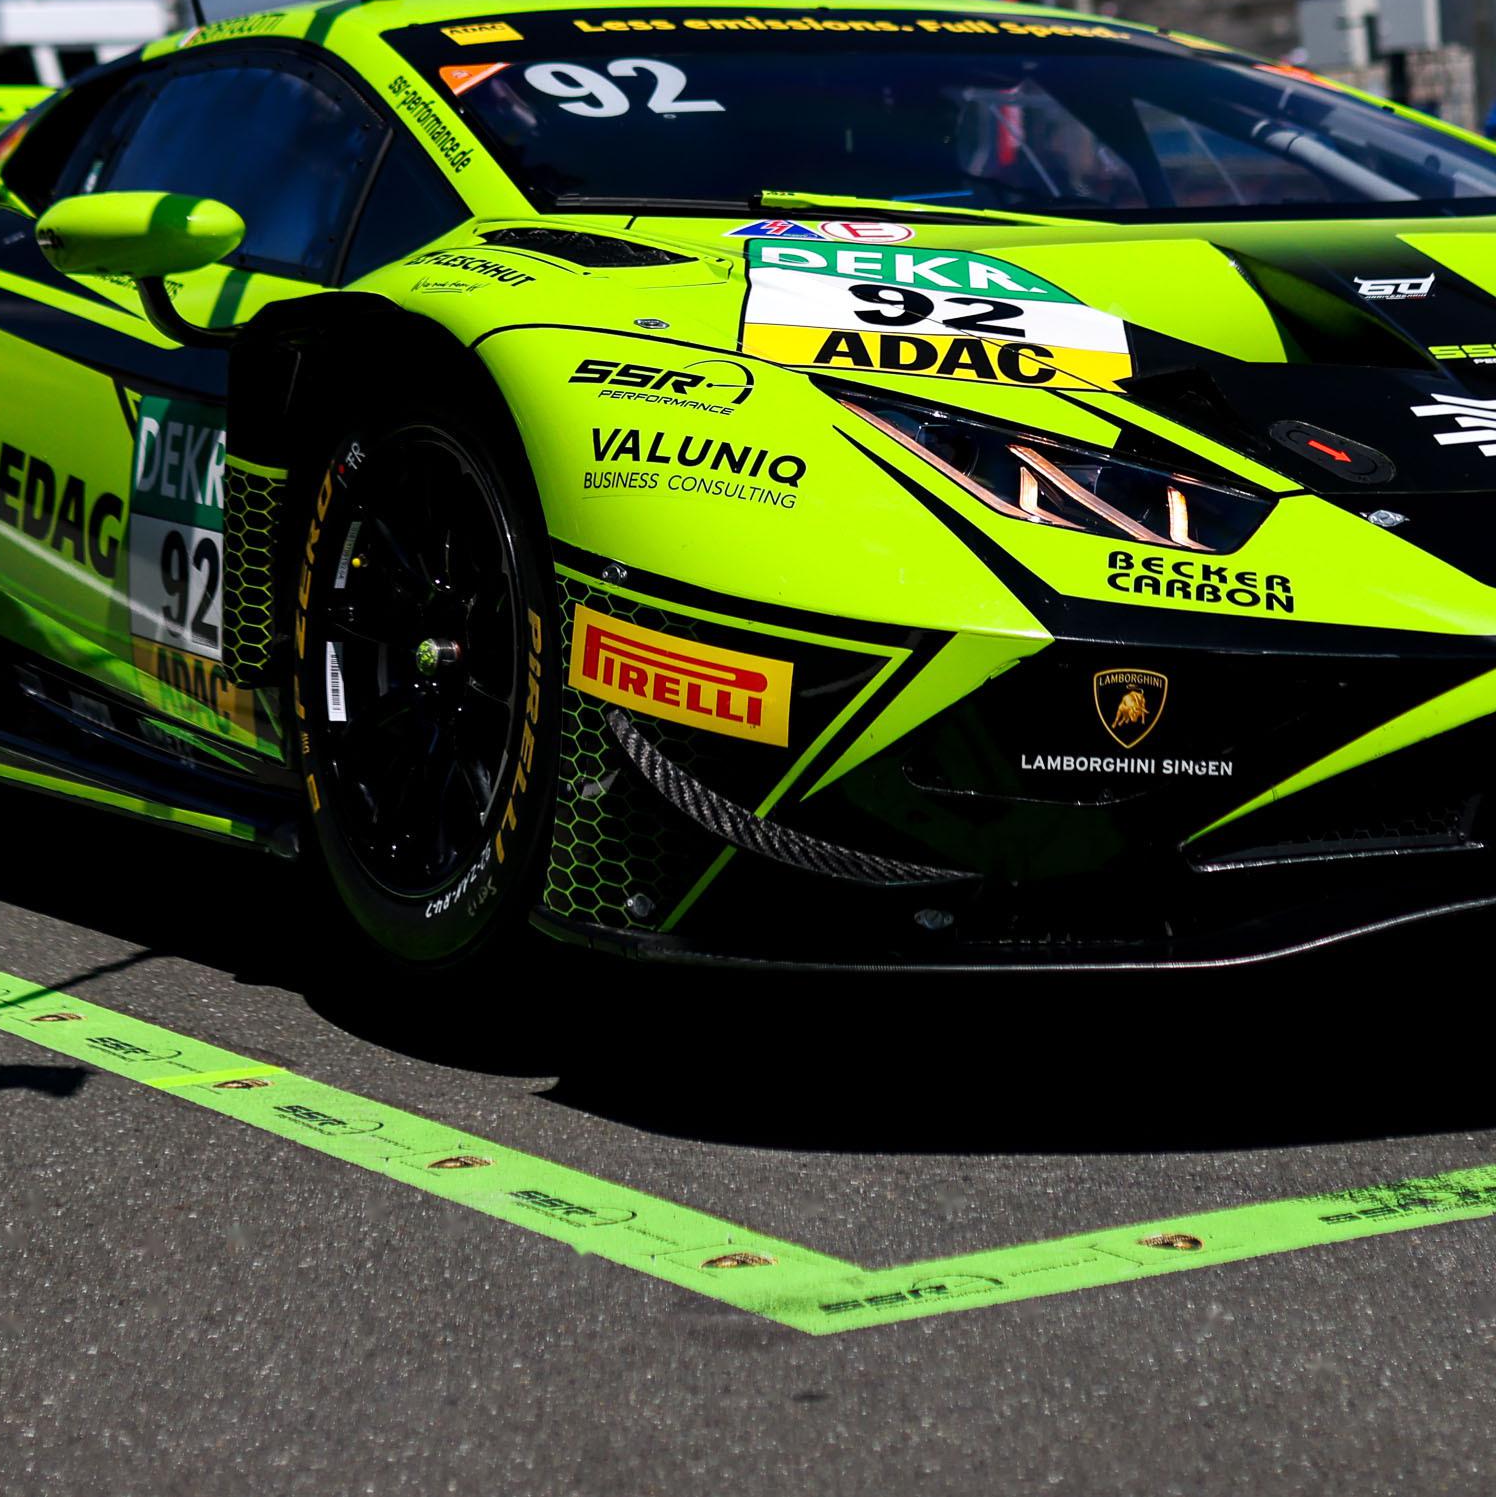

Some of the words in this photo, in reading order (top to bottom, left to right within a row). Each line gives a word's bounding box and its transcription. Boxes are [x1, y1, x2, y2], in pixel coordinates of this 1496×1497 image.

[574, 18, 676, 33] Less
[684, 17, 913, 33] emissions.
[916, 19, 998, 35] Full
[524, 59, 726, 117] 92
[388, 75, 474, 173] ssr-performance.de
[761, 247, 1049, 294] DEKR
[849, 284, 1025, 337] 92
[568, 359, 705, 395] SSR
[813, 331, 1056, 384] ADAC
[598, 390, 735, 415] PERFORMANCE
[135, 416, 226, 510] DEKR
[592, 428, 807, 488] VALUNIQ
[584, 472, 659, 490] BUSINESS
[668, 475, 797, 509] CONSULTING
[160, 531, 221, 650] 92
[1107, 572, 1295, 614] CARBON
[1108, 551, 1292, 594] BECKER
[582, 624, 768, 727] PIRELLI
[1099, 673, 1163, 688] LAMBORGHINI
[495, 607, 541, 865] PIRELLI
[1021, 754, 1156, 774] LAMBORGHINI
[1162, 759, 1233, 776] SINGEN
[507, 1190, 597, 1216] SSR
